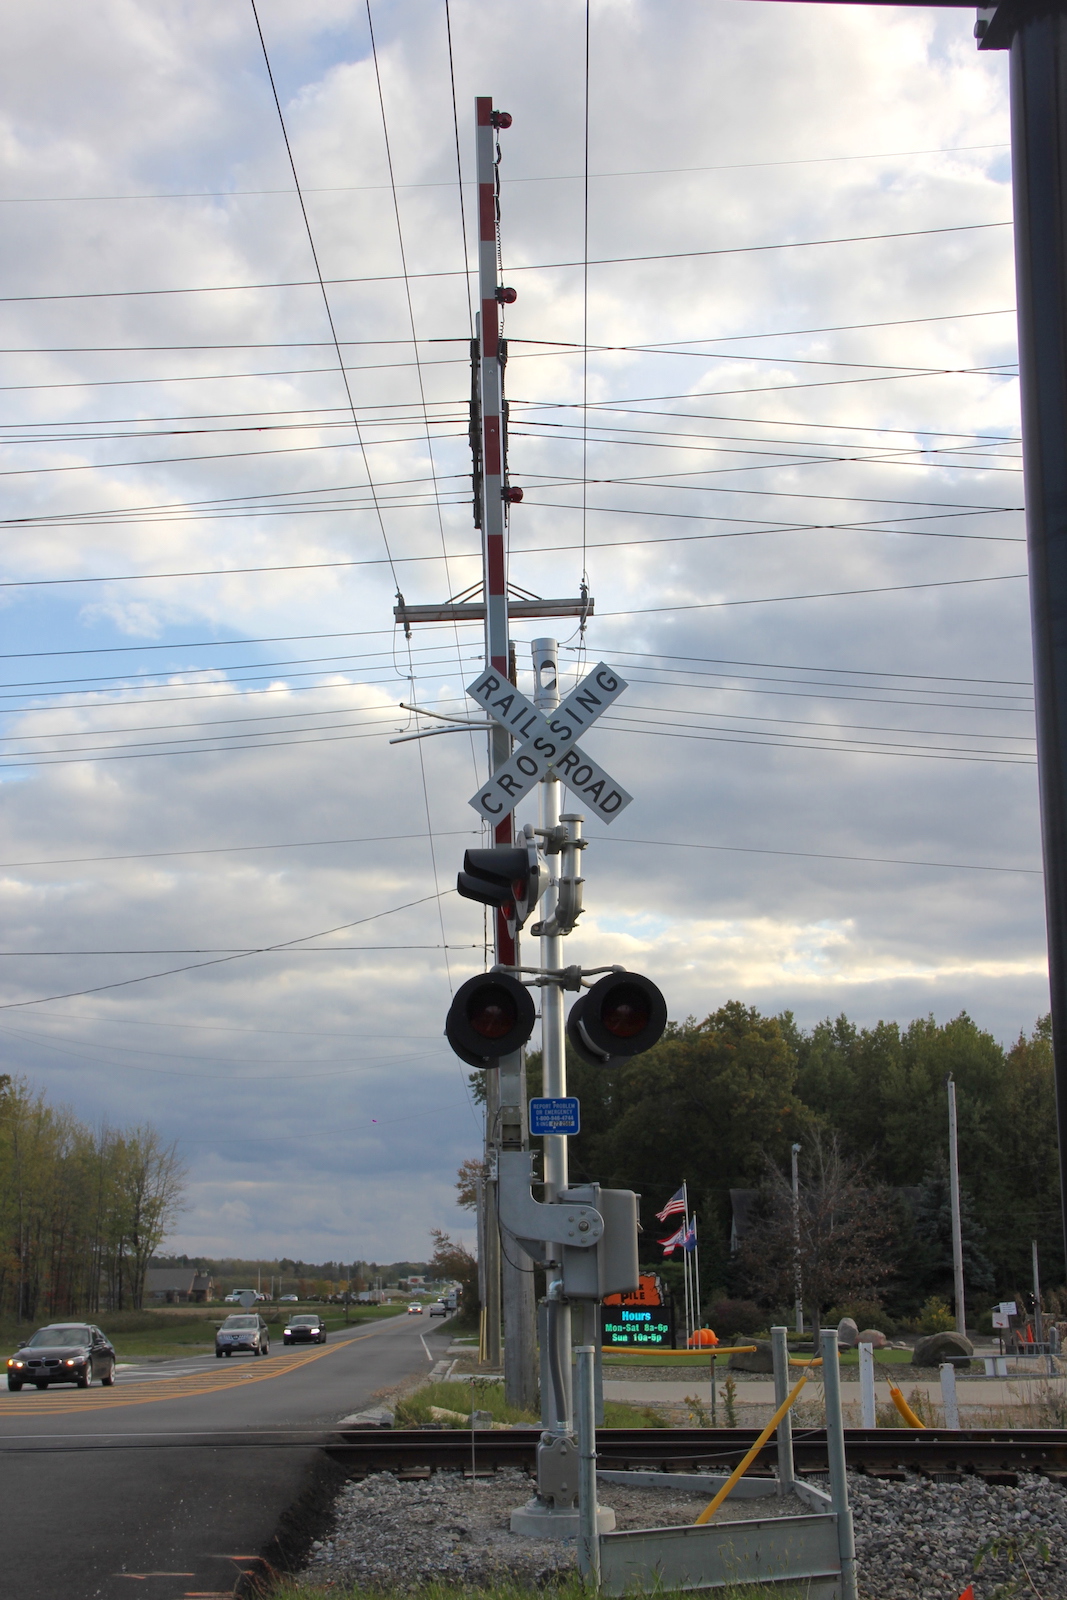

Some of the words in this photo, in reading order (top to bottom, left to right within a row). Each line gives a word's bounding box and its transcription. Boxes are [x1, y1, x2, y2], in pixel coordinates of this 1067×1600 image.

[480, 671, 618, 814] CROSSING
[621, 1292, 645, 1303] PILE
[622, 1311, 651, 1321] Hours
[644, 1323, 668, 1333] 8a-6p
[612, 1333, 628, 1342] Sun
[633, 1333, 662, 1342] 10a-5p
